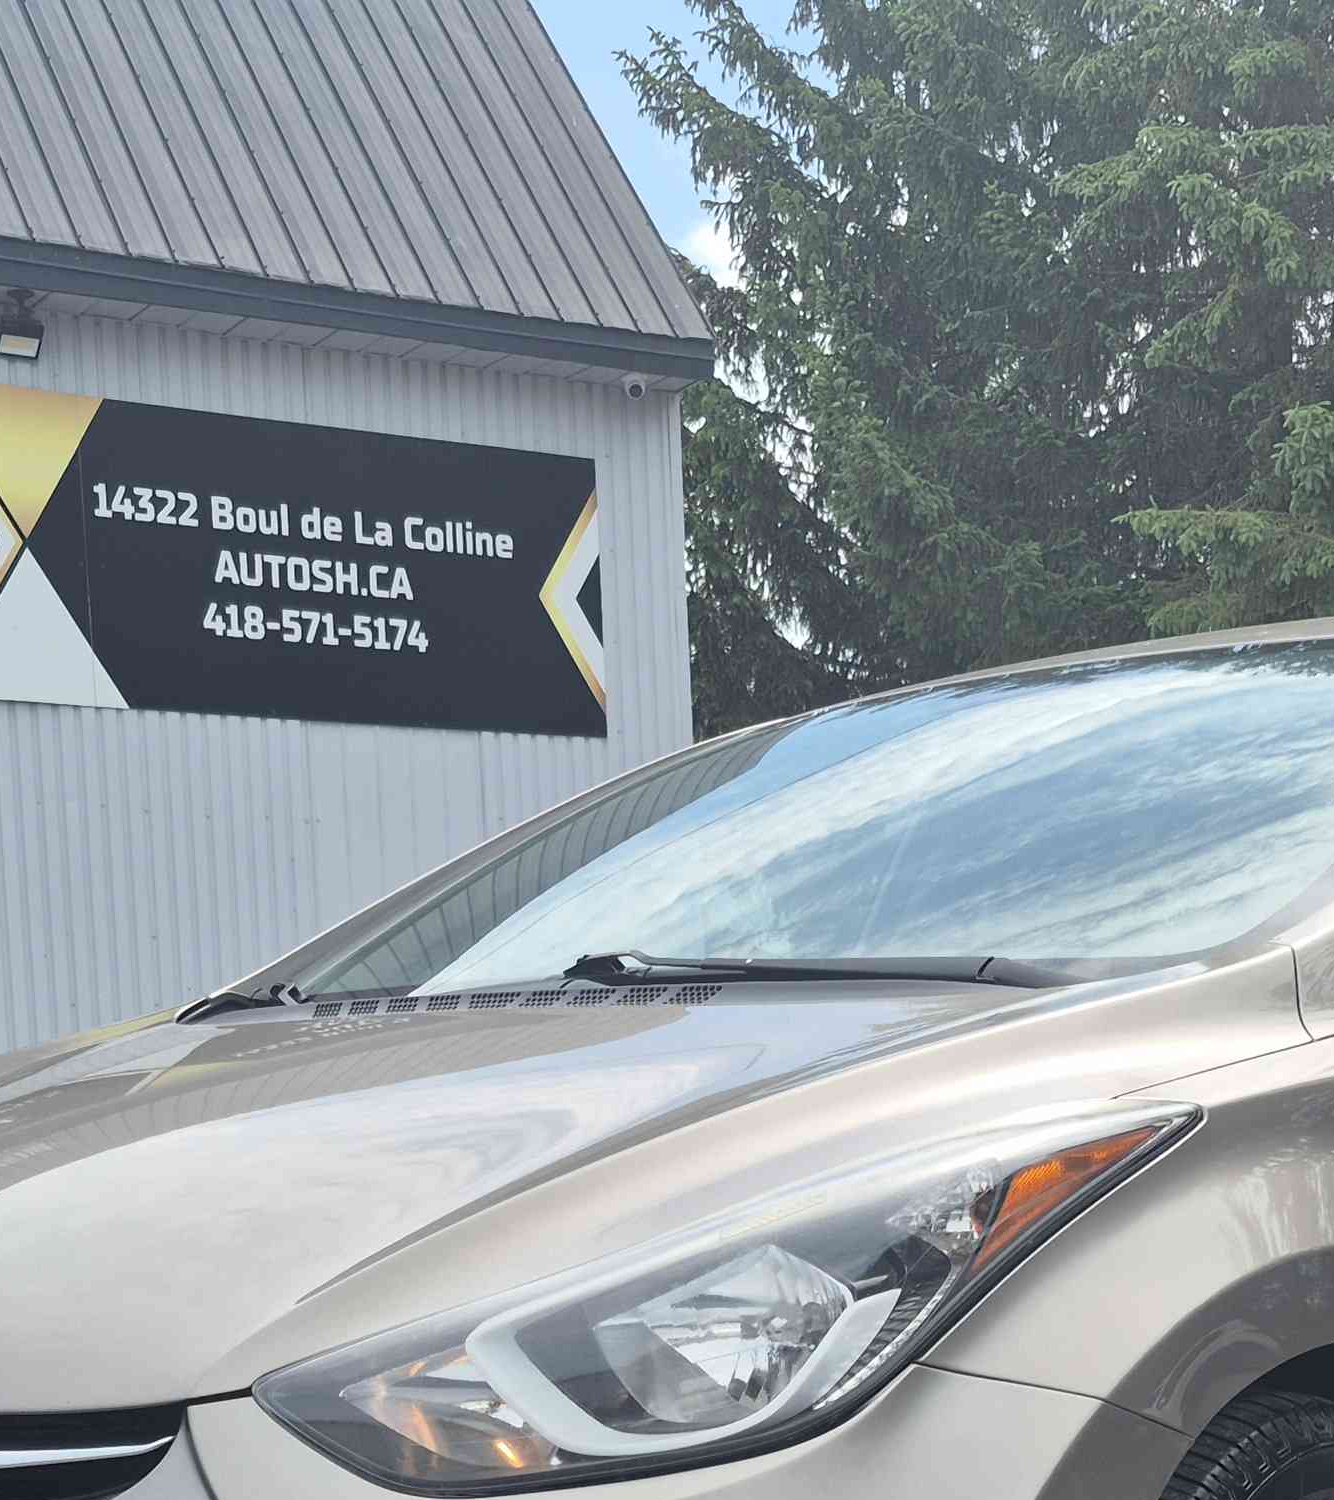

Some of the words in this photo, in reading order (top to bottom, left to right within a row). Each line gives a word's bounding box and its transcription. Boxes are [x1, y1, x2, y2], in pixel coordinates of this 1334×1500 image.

[93, 483, 200, 528] 14322
[211, 495, 289, 537] Boul
[300, 507, 343, 544] de
[354, 510, 394, 548] La
[404, 517, 514, 559] Colline
[214, 550, 414, 601] AUTOSH.CA
[202, 603, 429, 654] 418-571-5174
